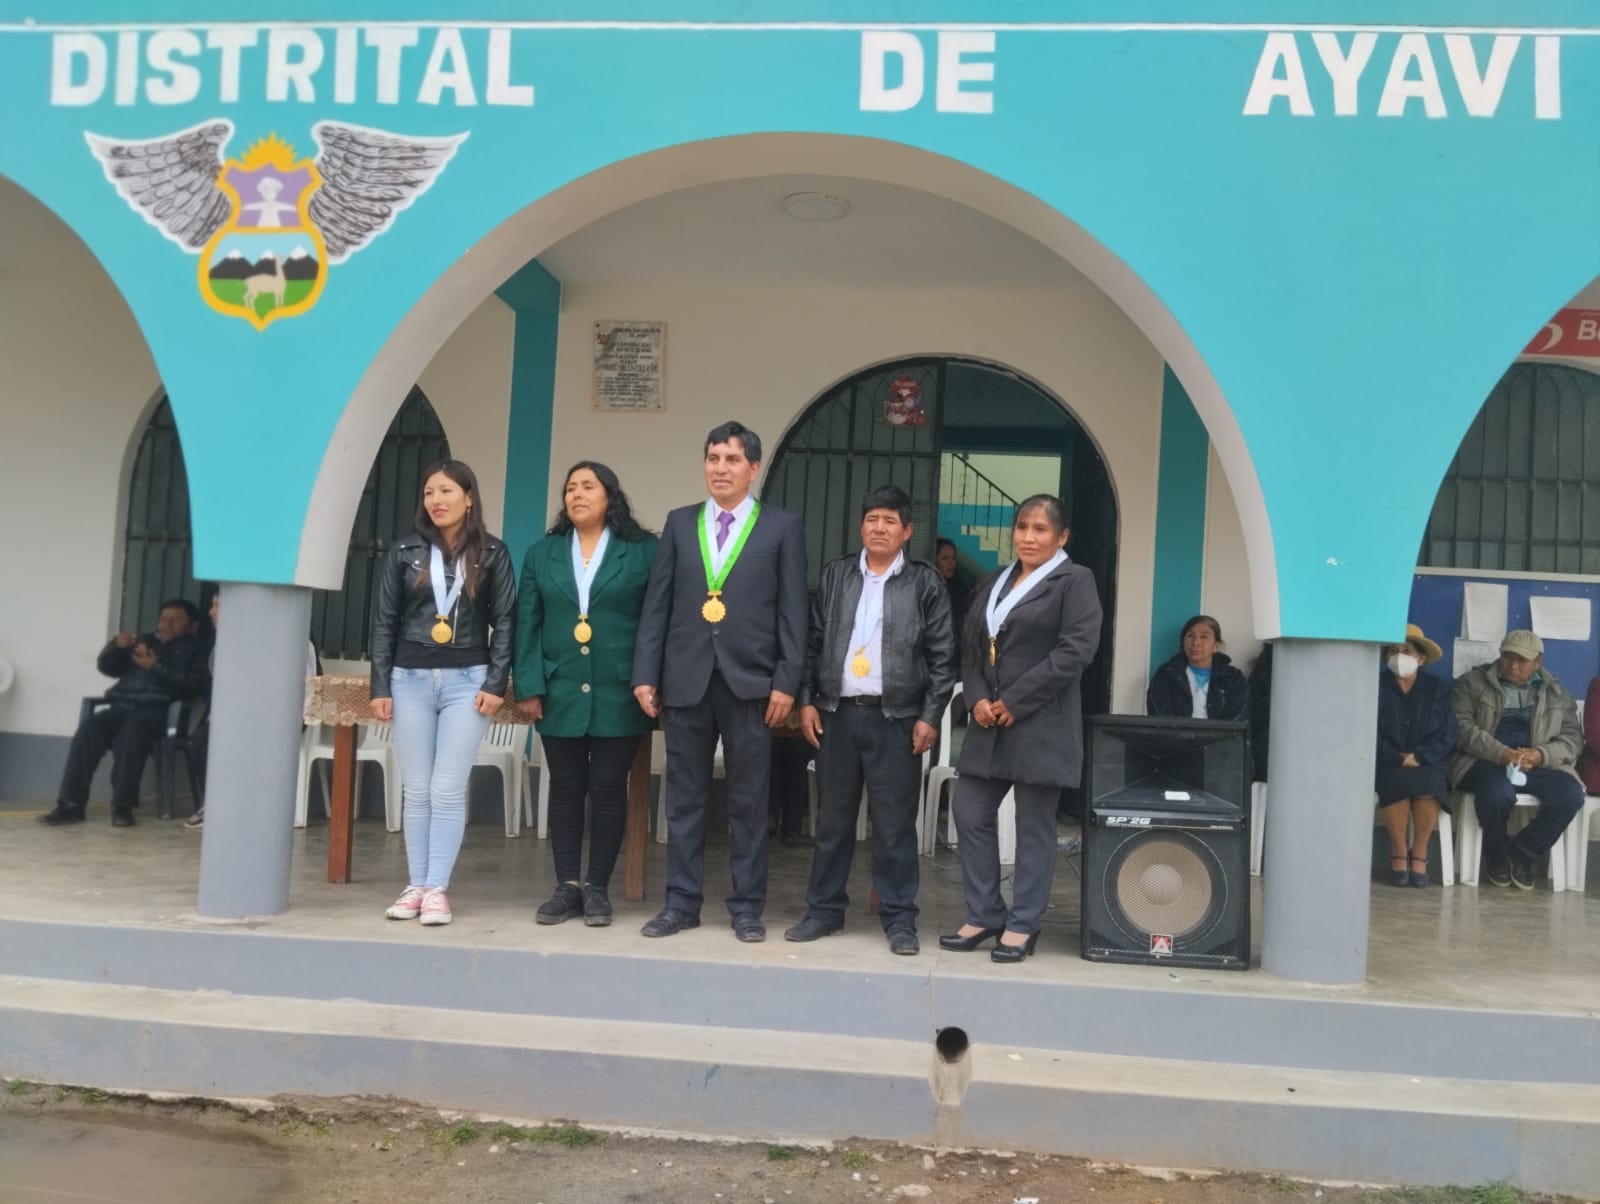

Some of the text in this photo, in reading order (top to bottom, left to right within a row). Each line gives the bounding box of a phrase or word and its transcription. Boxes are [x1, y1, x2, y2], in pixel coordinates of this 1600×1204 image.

[51, 28, 1561, 120] DISTRITAL DE AYAVI
